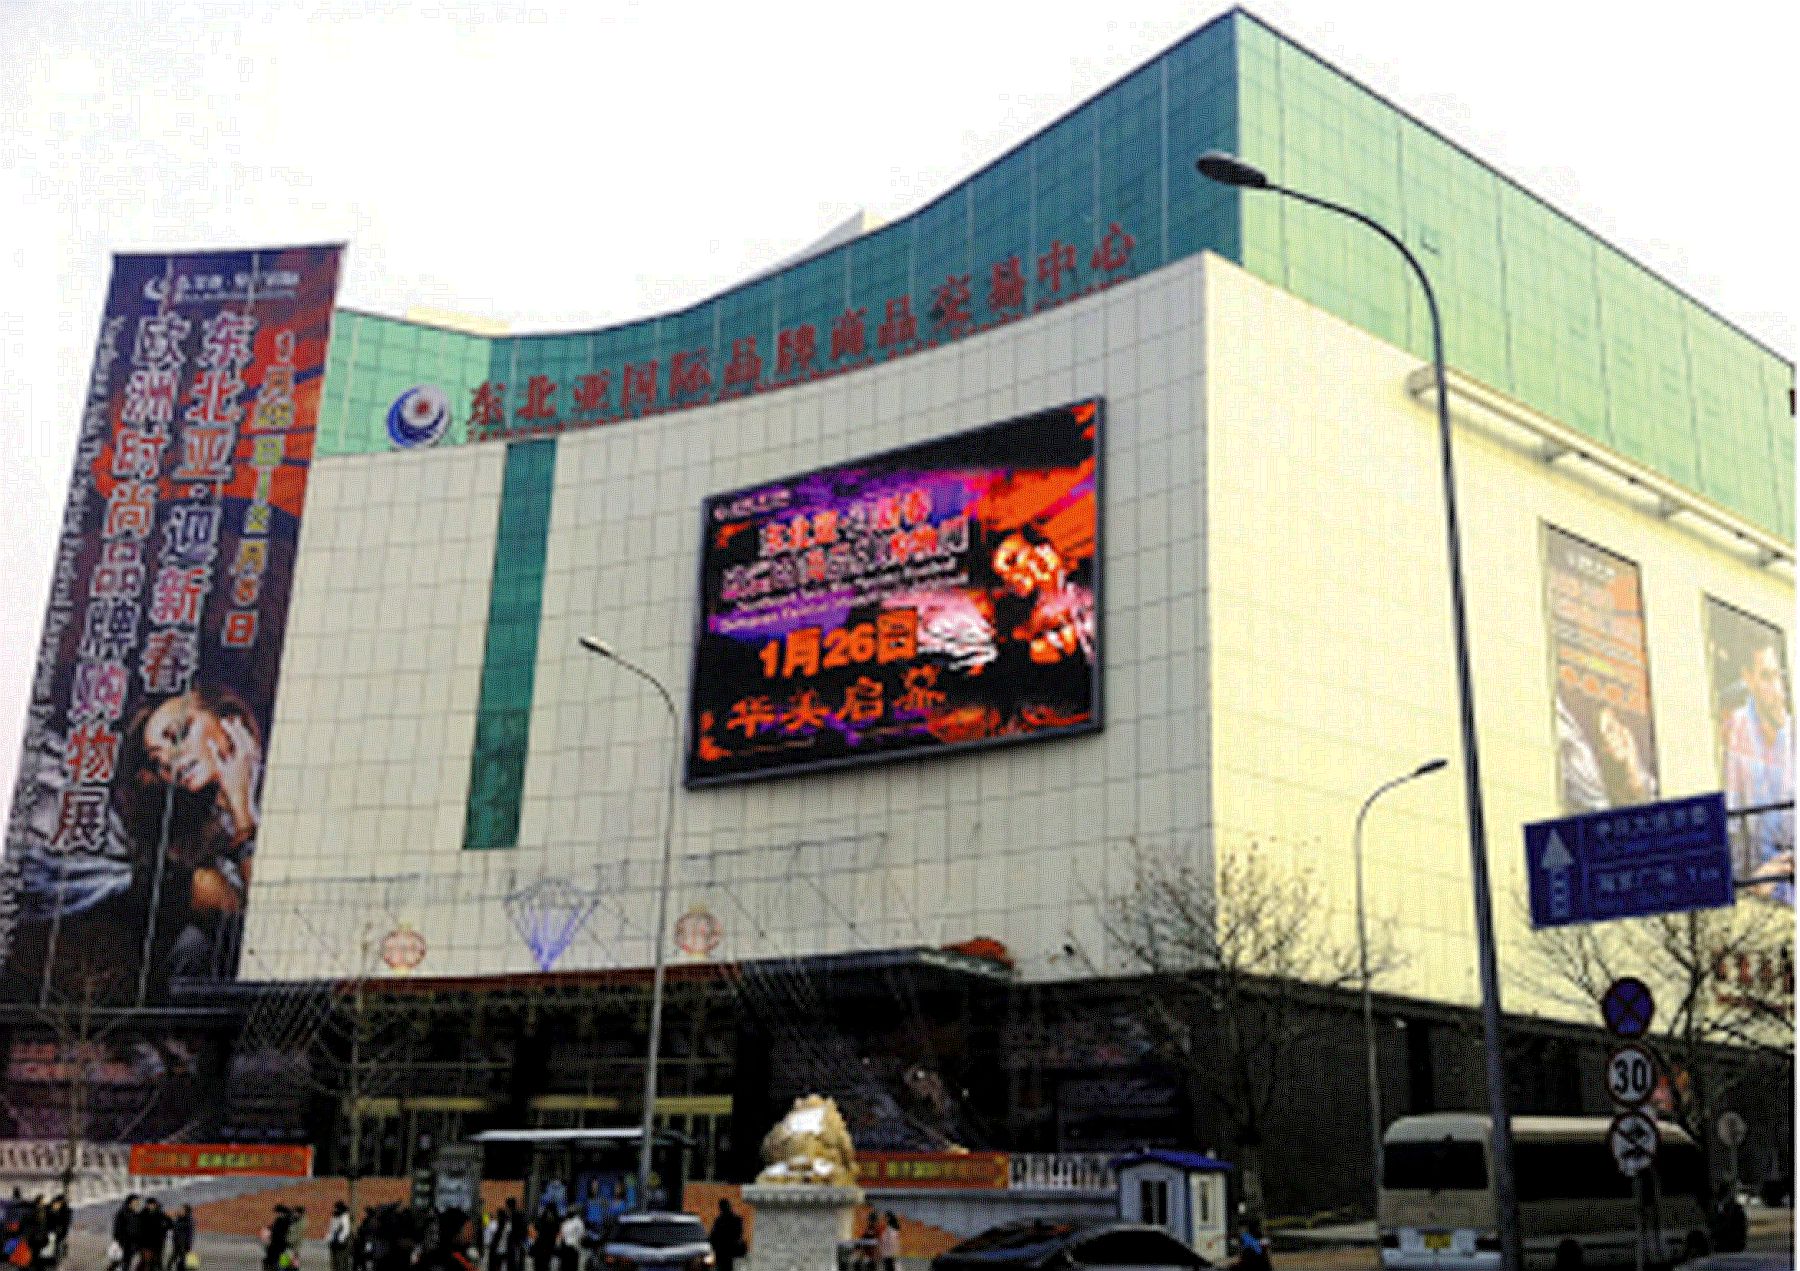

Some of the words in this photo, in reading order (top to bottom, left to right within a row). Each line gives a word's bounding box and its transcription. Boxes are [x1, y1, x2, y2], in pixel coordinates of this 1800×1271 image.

[466, 222, 1135, 426] 东北亚国际品牌商品交易中心
[759, 605, 918, 678] 1月26日
[1613, 1058, 1647, 1094] 30
